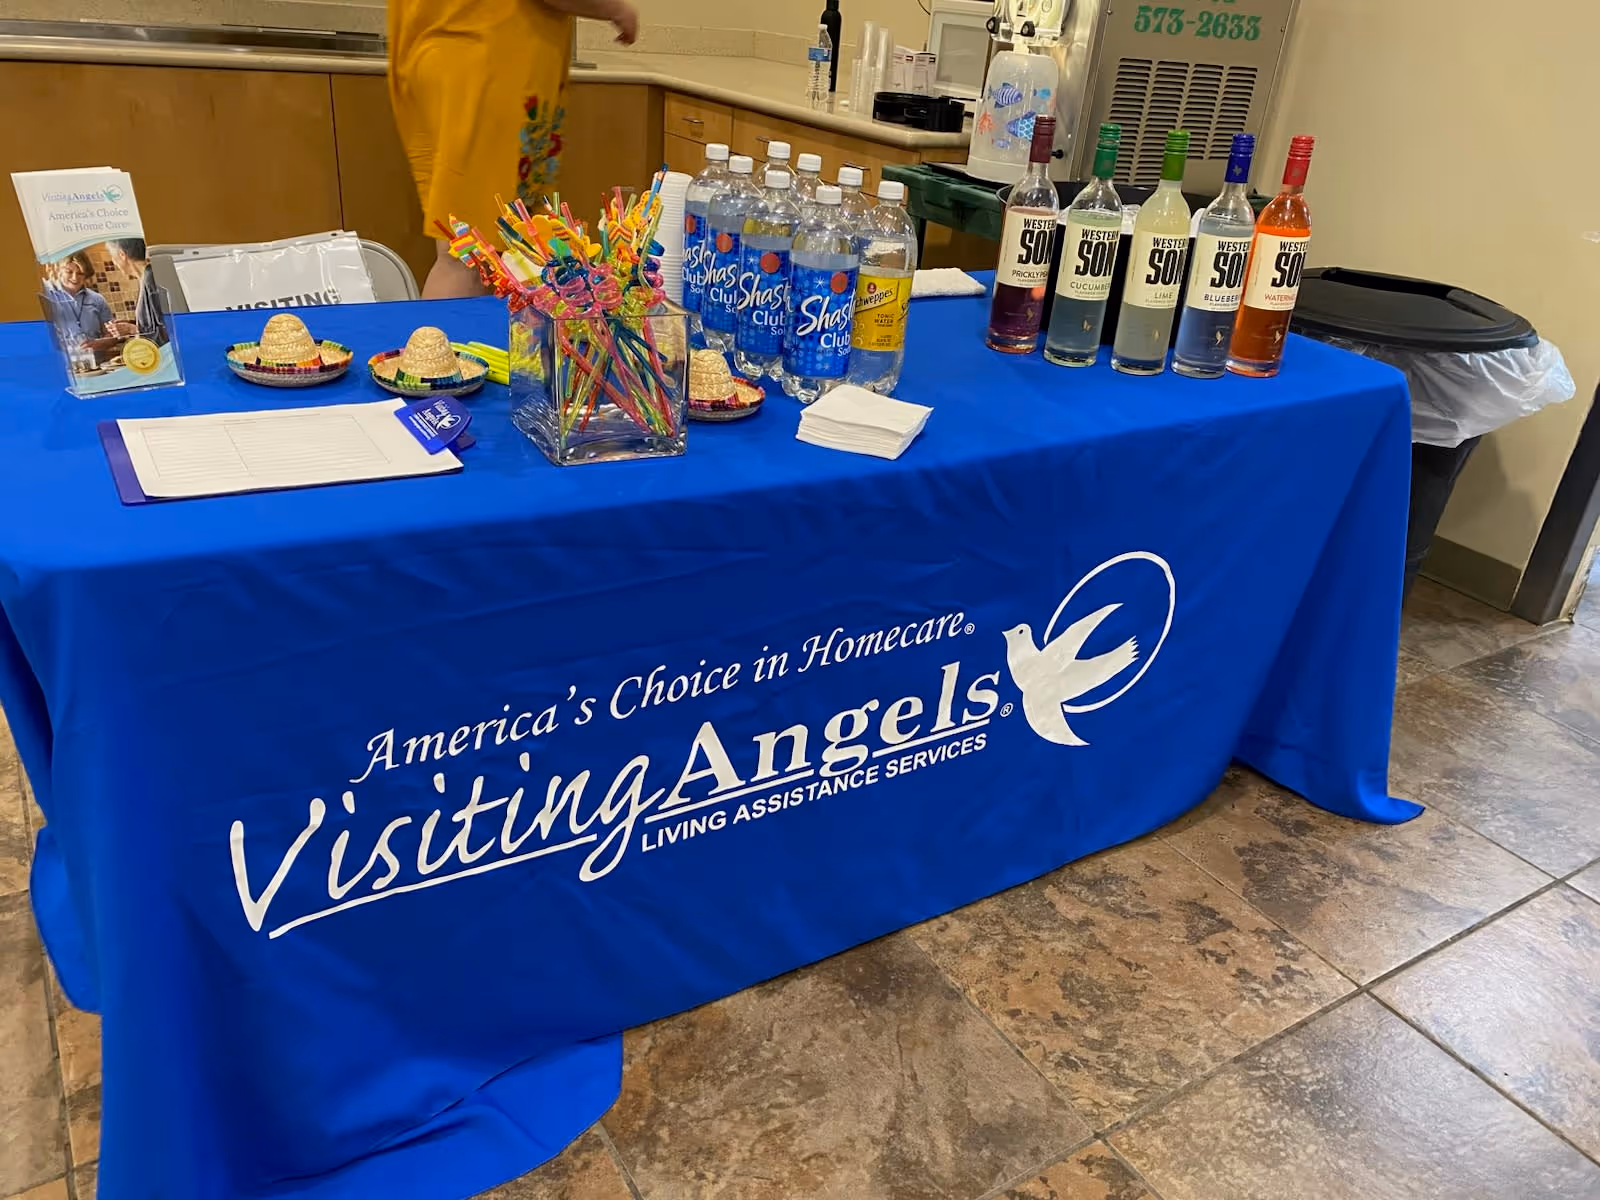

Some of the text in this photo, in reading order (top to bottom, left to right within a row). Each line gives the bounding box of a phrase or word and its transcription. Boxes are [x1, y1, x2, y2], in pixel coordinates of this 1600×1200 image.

[1133, 5, 1262, 41] 573-2633
[49, 206, 128, 221] America's Choice
[63, 222, 73, 232] in
[74, 221, 104, 232] Home
[1023, 218, 1056, 229] WESTER
[1153, 237, 1187, 249] WESTER
[1218, 240, 1251, 252] WESTE
[1280, 240, 1309, 252] WESTE
[1075, 240, 1117, 277] SON
[703, 251, 737, 288] Shas
[1012, 269, 1040, 279] PRICKLY
[690, 284, 704, 293] So
[737, 272, 790, 311] Shast
[1070, 281, 1110, 291] CUCUMBE
[225, 288, 342, 311] SITING
[855, 287, 893, 308] chweppes
[1204, 294, 1240, 302] BLUEBER
[725, 304, 737, 313] So
[797, 289, 856, 336] Shast
[771, 326, 783, 336] So
[820, 333, 850, 348] Club
[350, 685, 597, 784] America's
[610, 658, 741, 720] Choice
[753, 645, 790, 683] in
[642, 733, 988, 853] LIVING ASSISTANCE SERVICES
